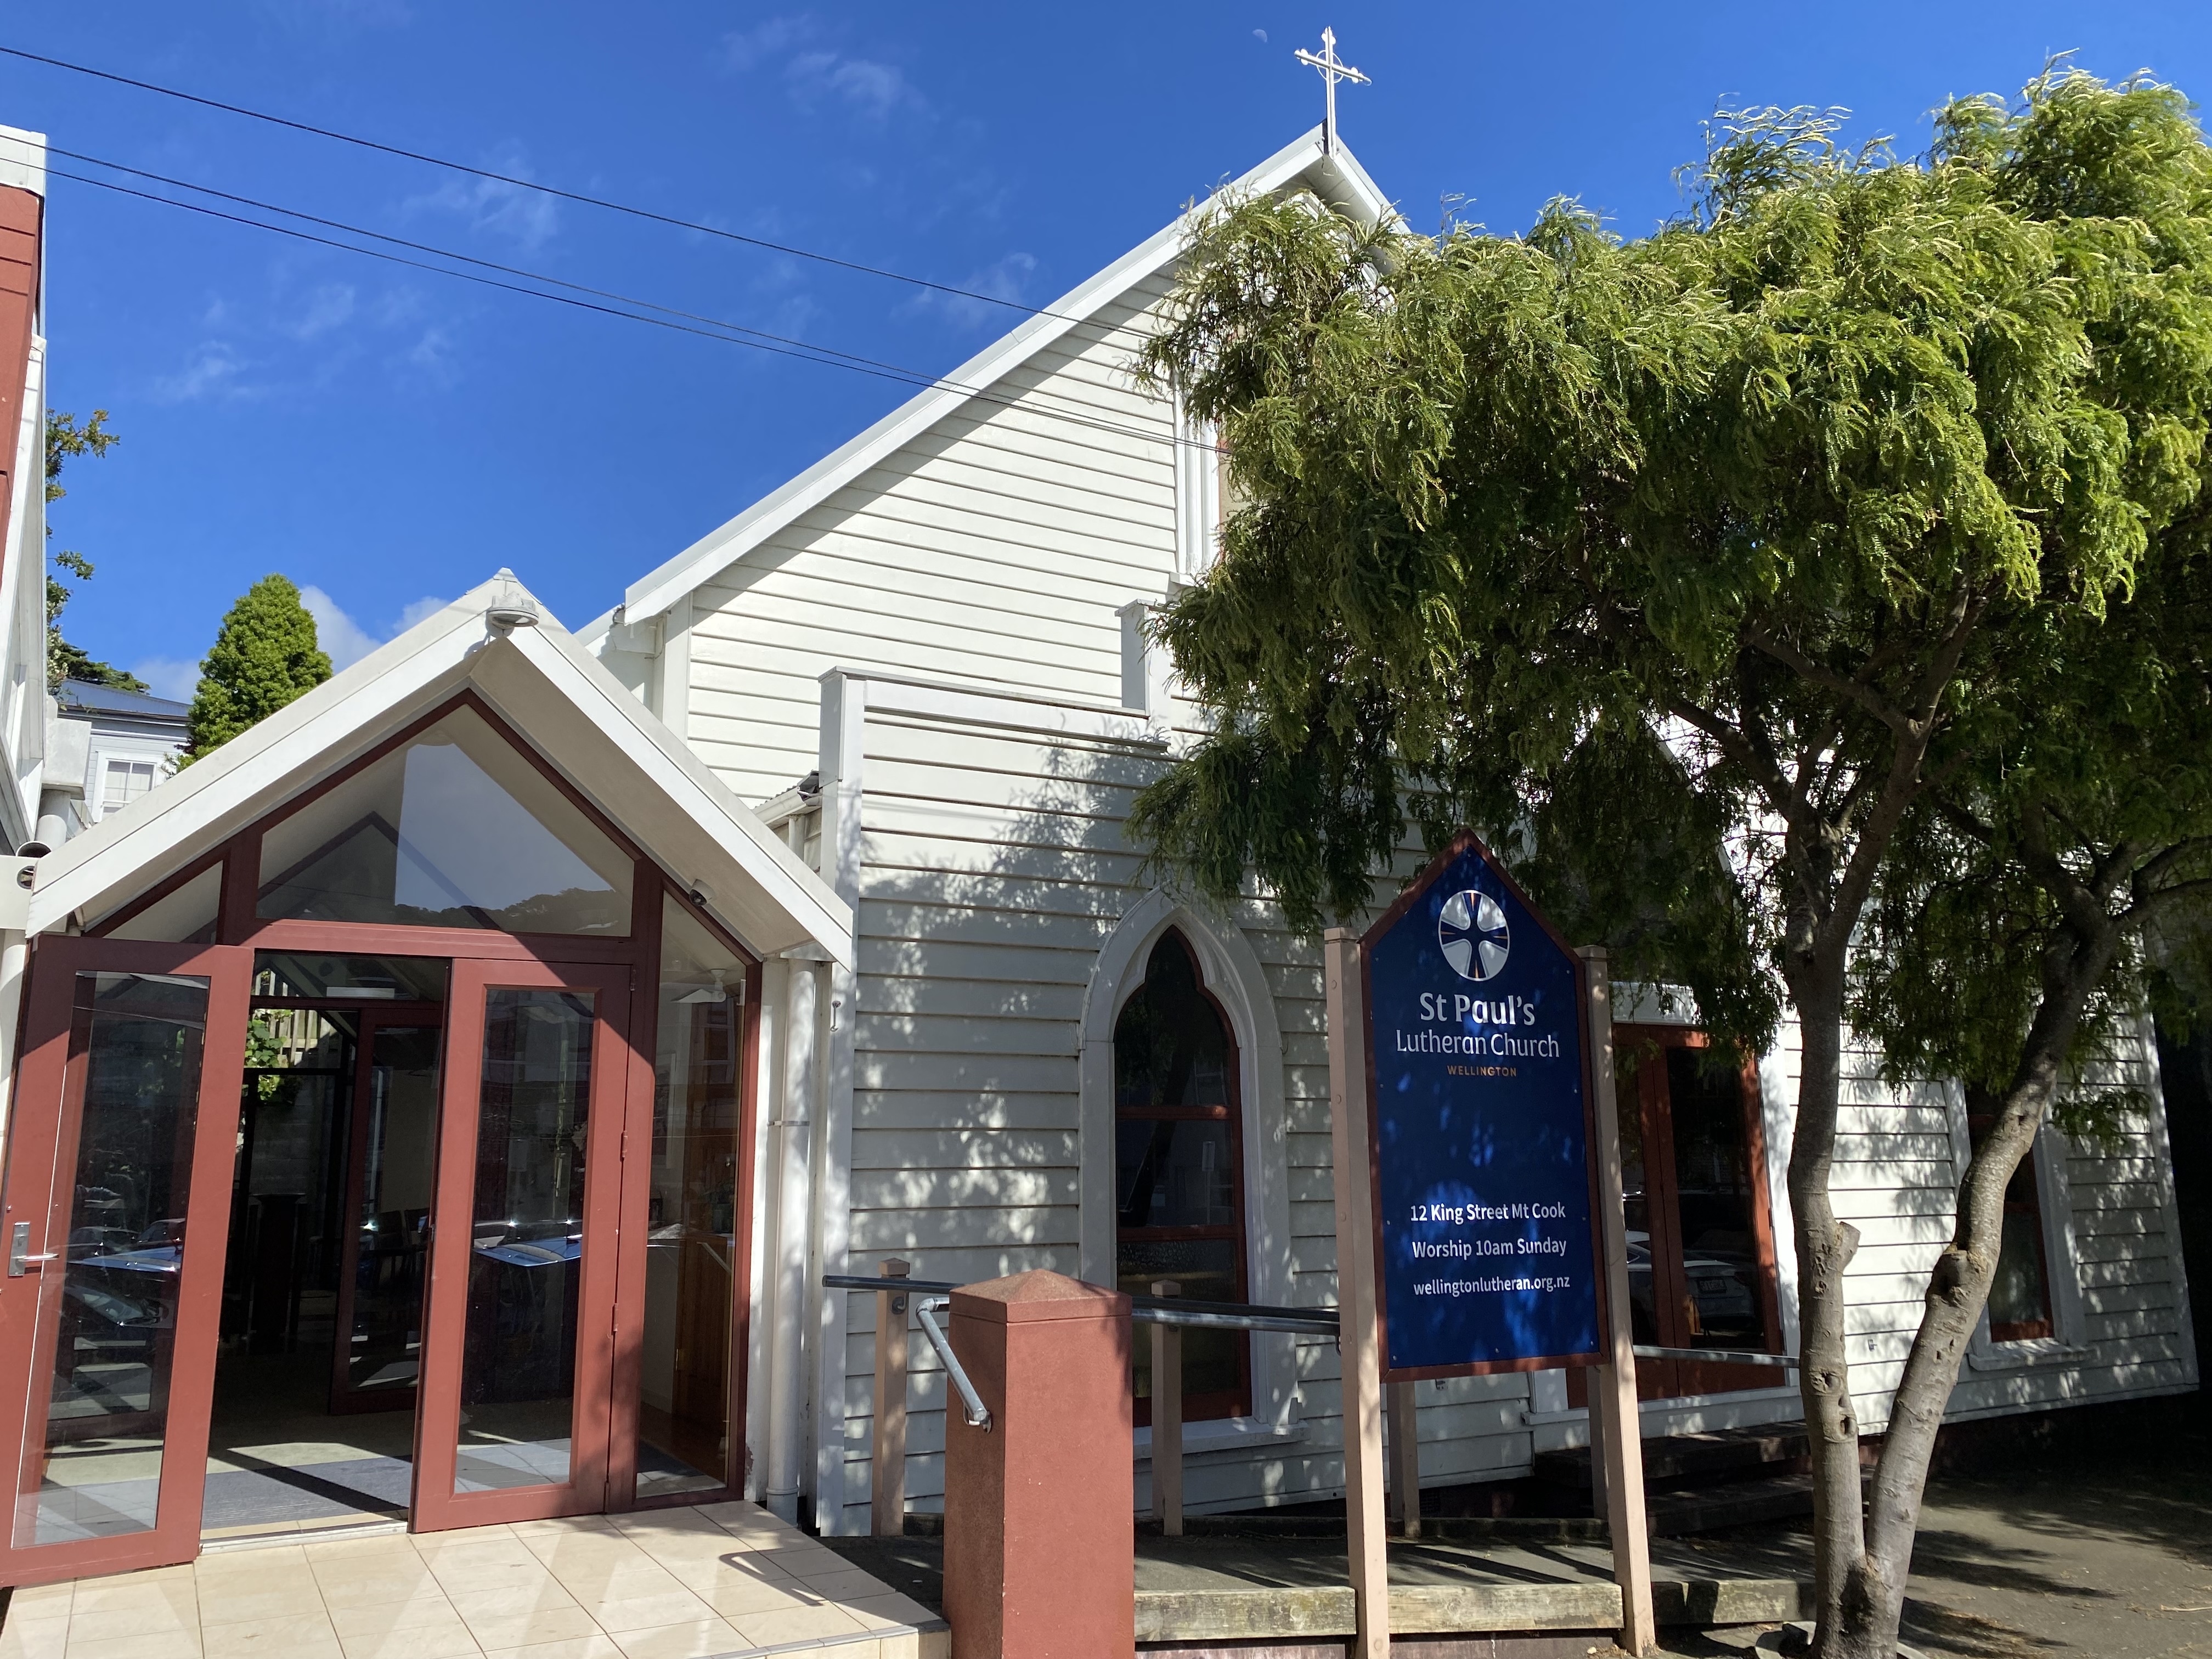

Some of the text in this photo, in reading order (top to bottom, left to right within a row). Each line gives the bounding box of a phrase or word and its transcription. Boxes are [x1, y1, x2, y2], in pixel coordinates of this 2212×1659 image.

[1420, 992, 1534, 1025] St Paul's
[1397, 1029, 1559, 1057] Lutheran Church
[1448, 1065, 1516, 1076] WELLINGTON
[1411, 1201, 1565, 1224] 12 King Street Mt Cook
[1412, 1236, 1566, 1260] Worship 10am Sunday
[1414, 1276, 1570, 1297] wellingtonlutheran.org.nz
